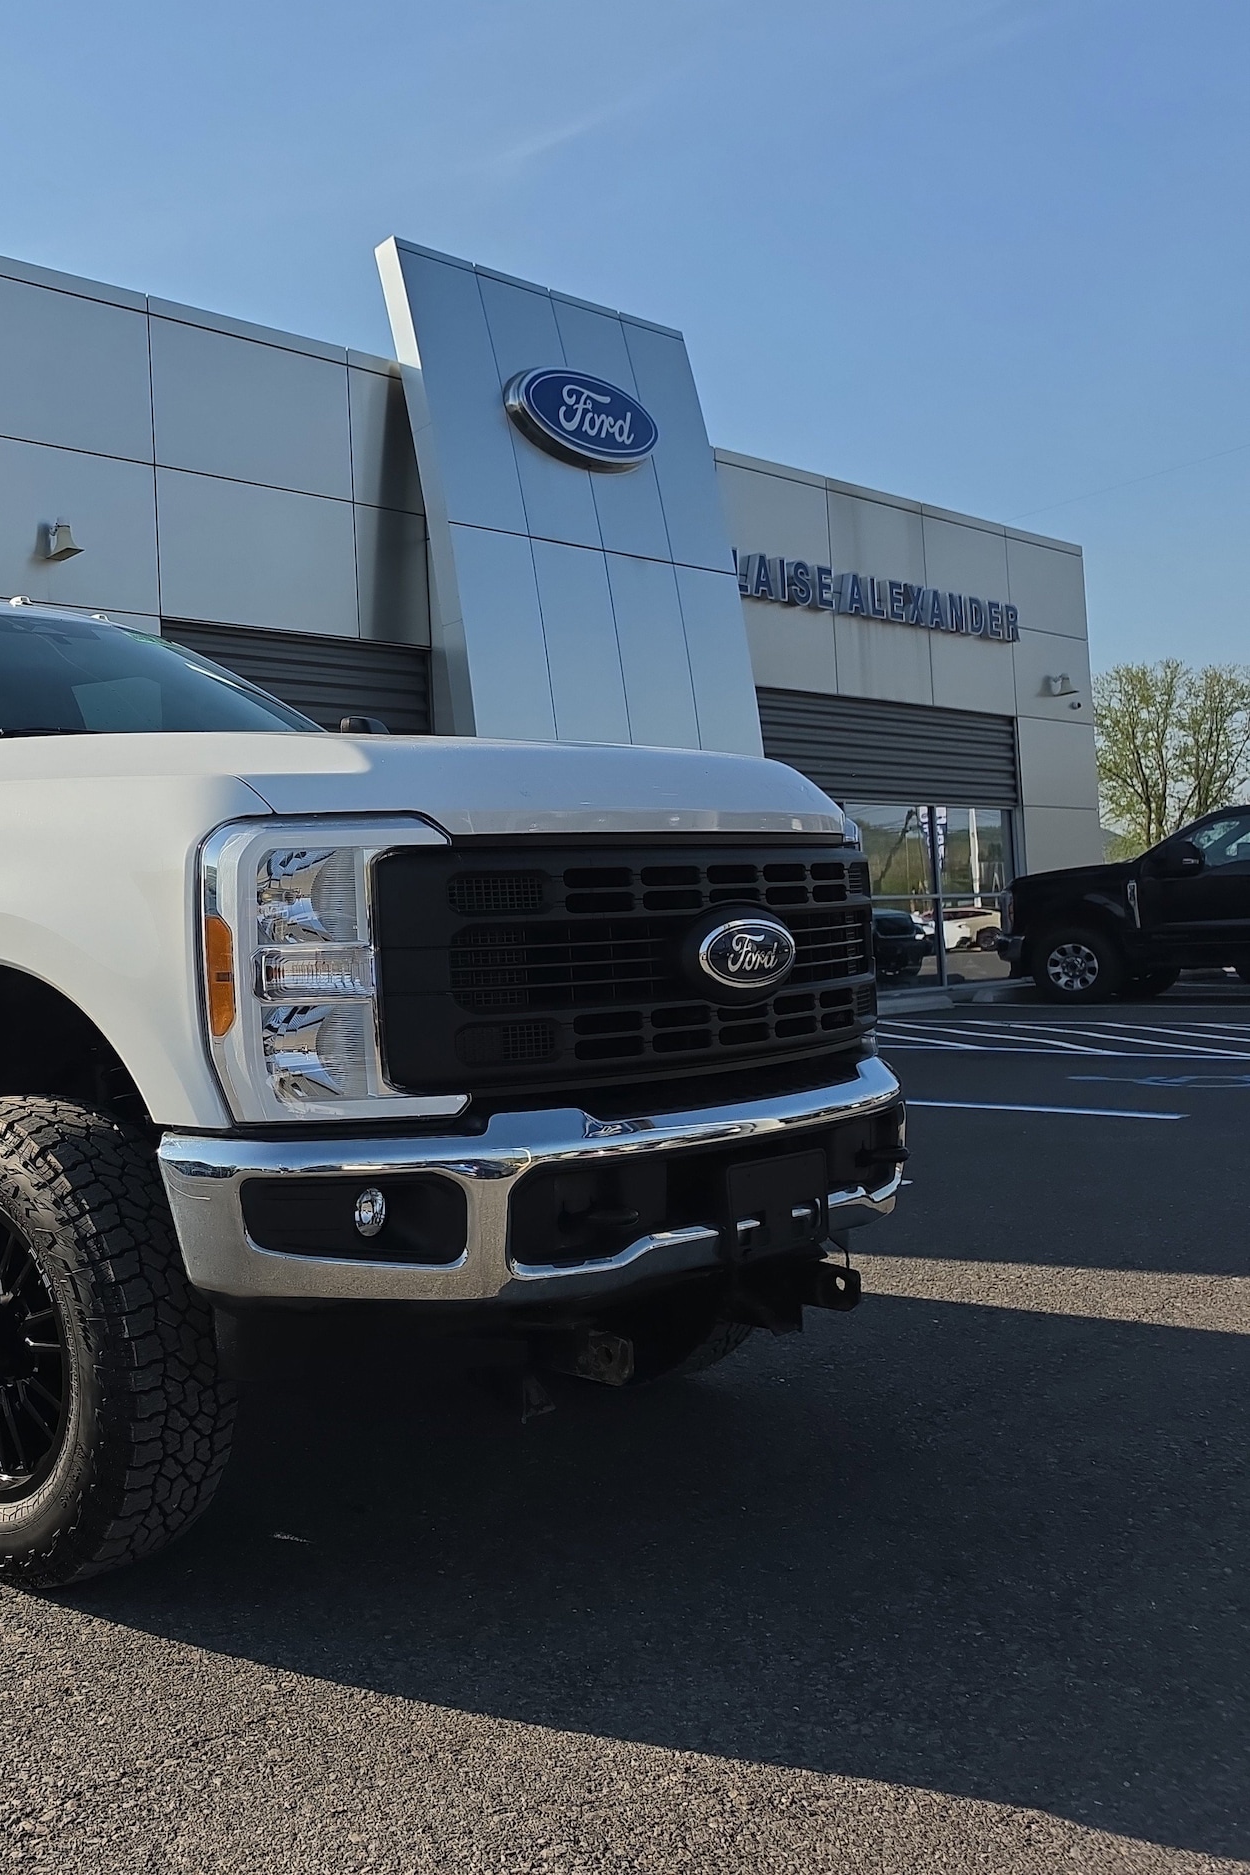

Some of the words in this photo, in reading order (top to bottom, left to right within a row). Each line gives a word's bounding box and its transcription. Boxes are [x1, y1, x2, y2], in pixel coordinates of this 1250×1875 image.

[558, 384, 635, 445] Ford
[842, 571, 1021, 643] ALEXANDER
[727, 933, 779, 973] Ford
